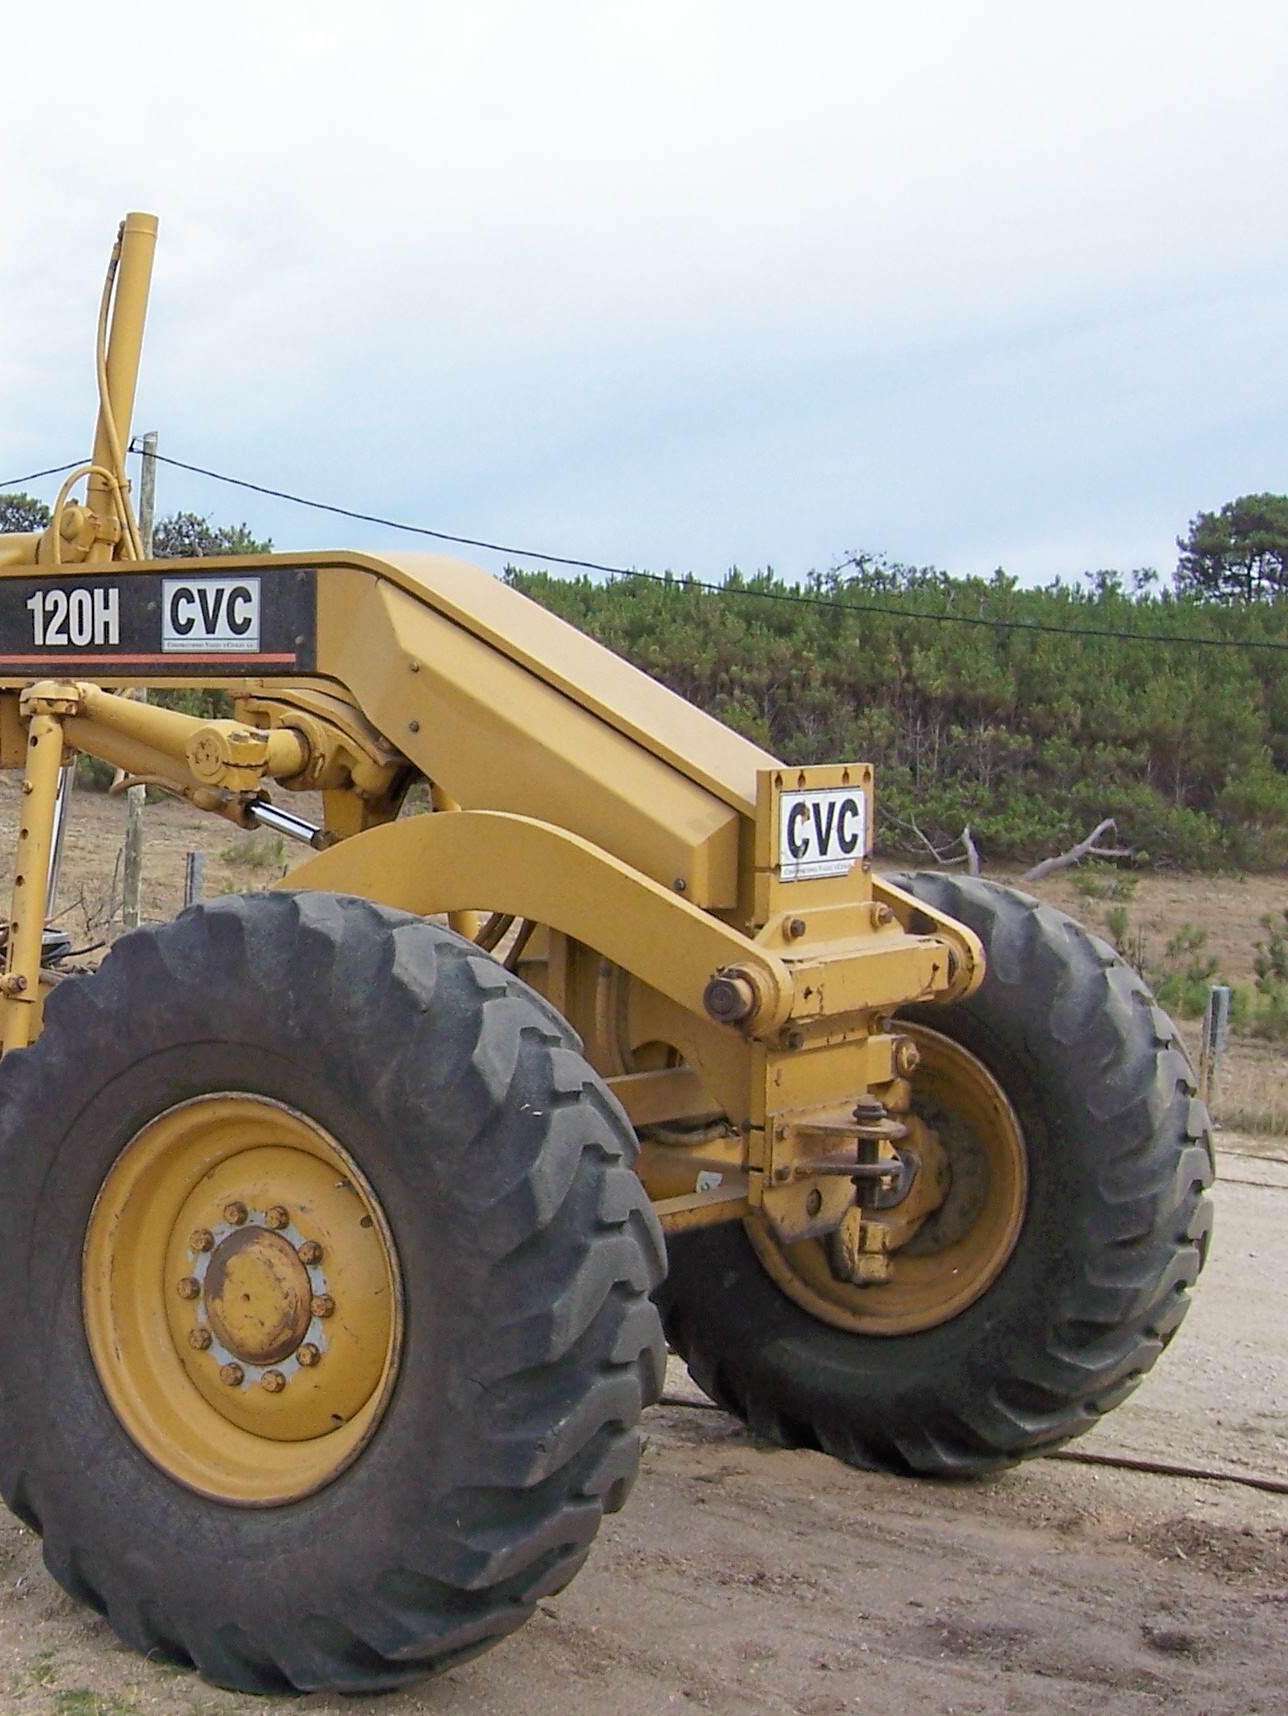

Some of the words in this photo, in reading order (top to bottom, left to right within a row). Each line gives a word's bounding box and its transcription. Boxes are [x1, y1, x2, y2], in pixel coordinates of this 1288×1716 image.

[26, 587, 121, 646] 120H
[170, 586, 253, 636] CVC
[786, 798, 860, 860] CVC
